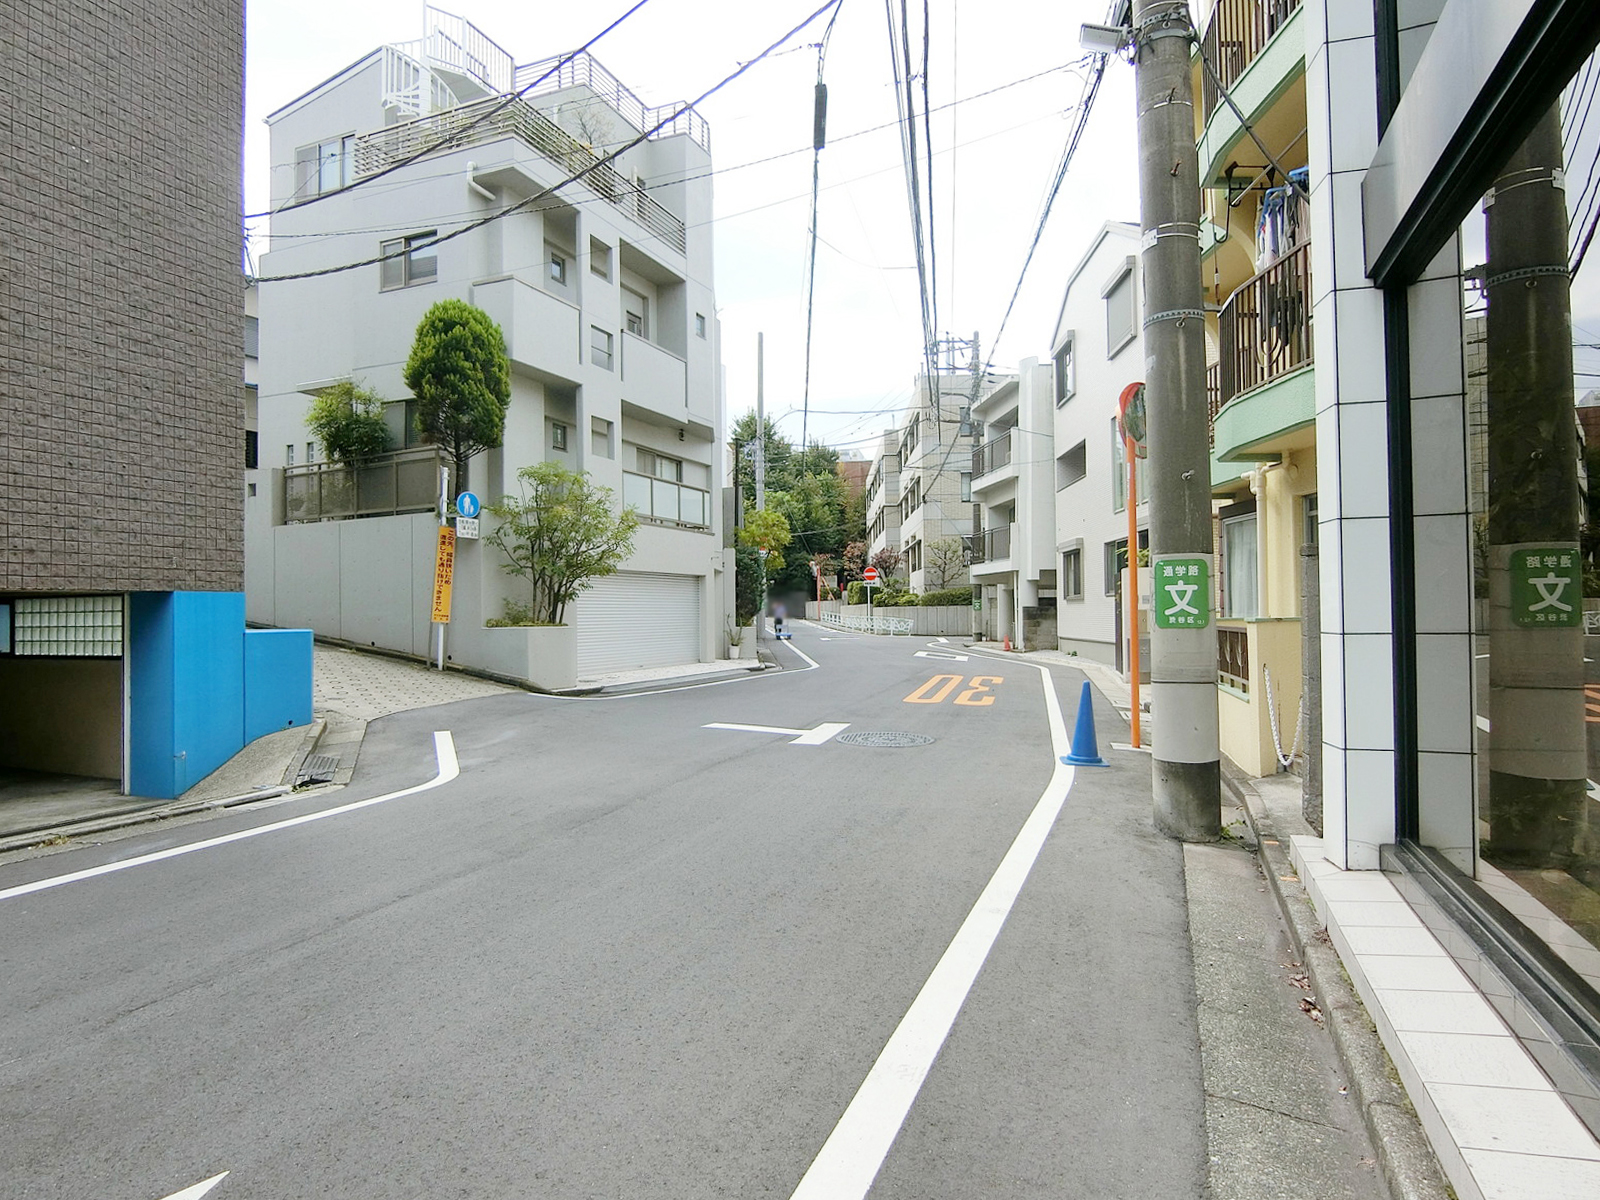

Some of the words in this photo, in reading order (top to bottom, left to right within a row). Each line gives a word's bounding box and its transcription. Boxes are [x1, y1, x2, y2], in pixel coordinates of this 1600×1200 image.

[1163, 565, 1199, 577] 通学路
[1164, 580, 1199, 616] 文
[1169, 616, 1195, 624] 渋谷区
[902, 674, 1004, 707] 30
